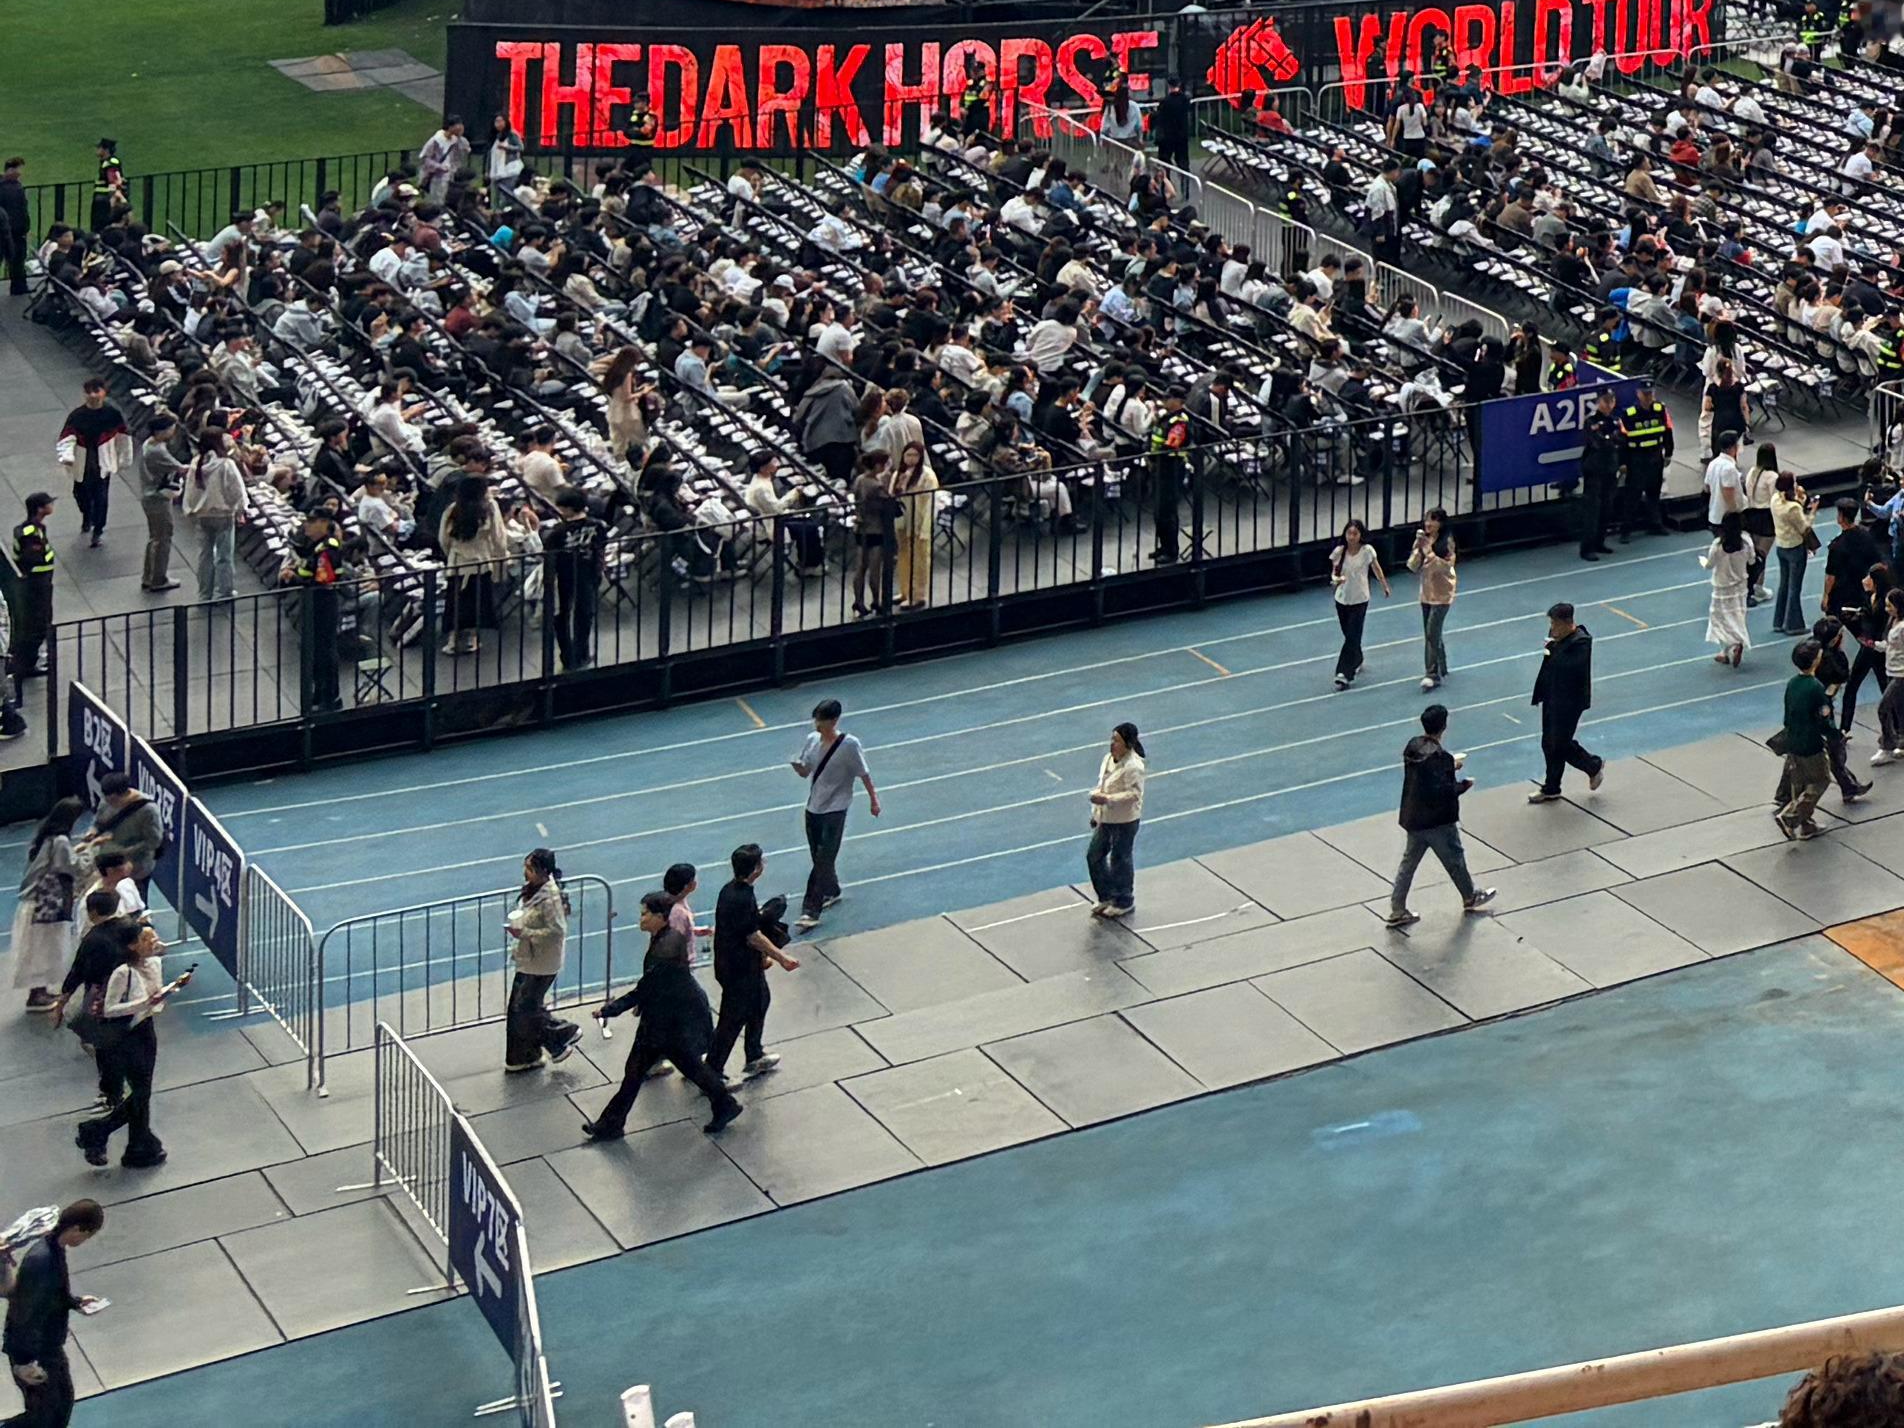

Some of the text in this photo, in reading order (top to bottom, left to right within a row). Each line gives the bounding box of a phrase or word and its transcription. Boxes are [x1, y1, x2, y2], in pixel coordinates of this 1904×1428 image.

[882, 30, 1160, 147] HORSE
[83, 707, 114, 770] B2区
[193, 823, 234, 908] VIP4区
[462, 1150, 510, 1272] VIP7区
